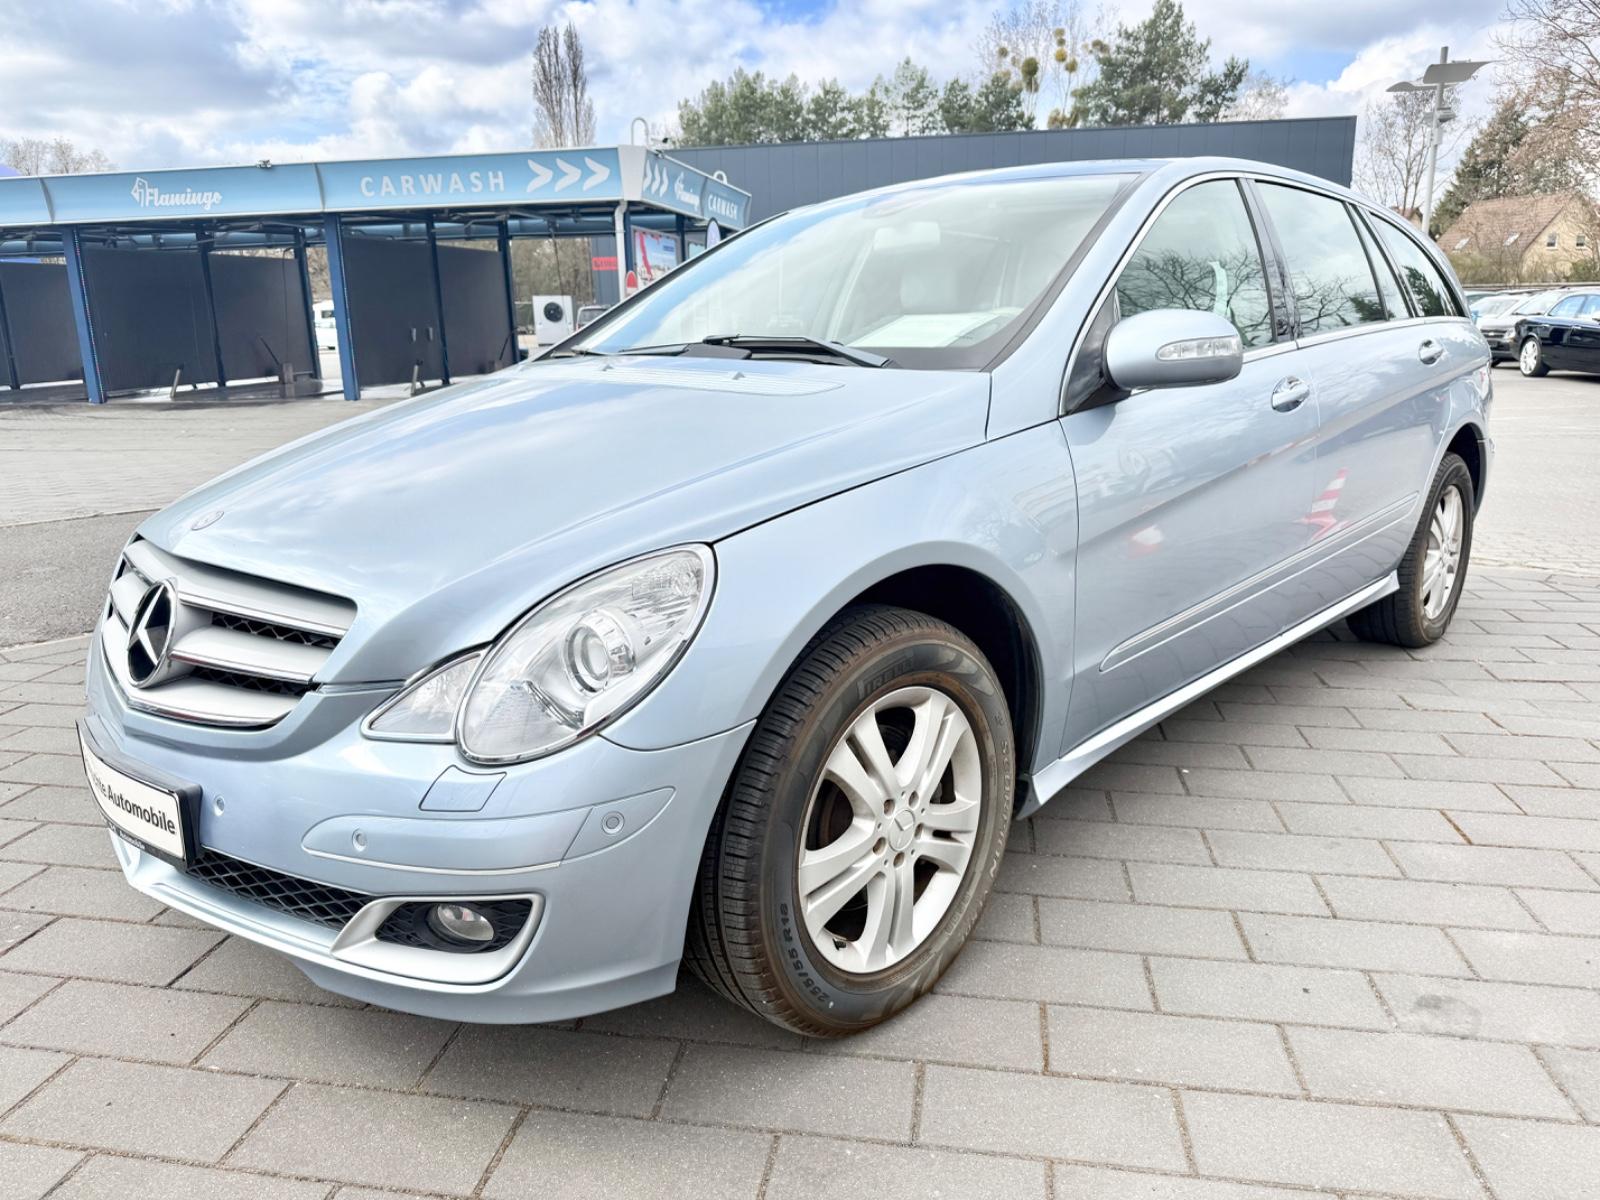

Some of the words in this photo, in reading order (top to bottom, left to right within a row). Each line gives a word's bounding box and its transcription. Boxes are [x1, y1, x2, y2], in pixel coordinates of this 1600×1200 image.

[360, 170, 506, 198] CARWASH
[146, 187, 223, 210] Flamingo
[707, 194, 738, 220] CARWASH
[108, 784, 176, 835] Automobile
